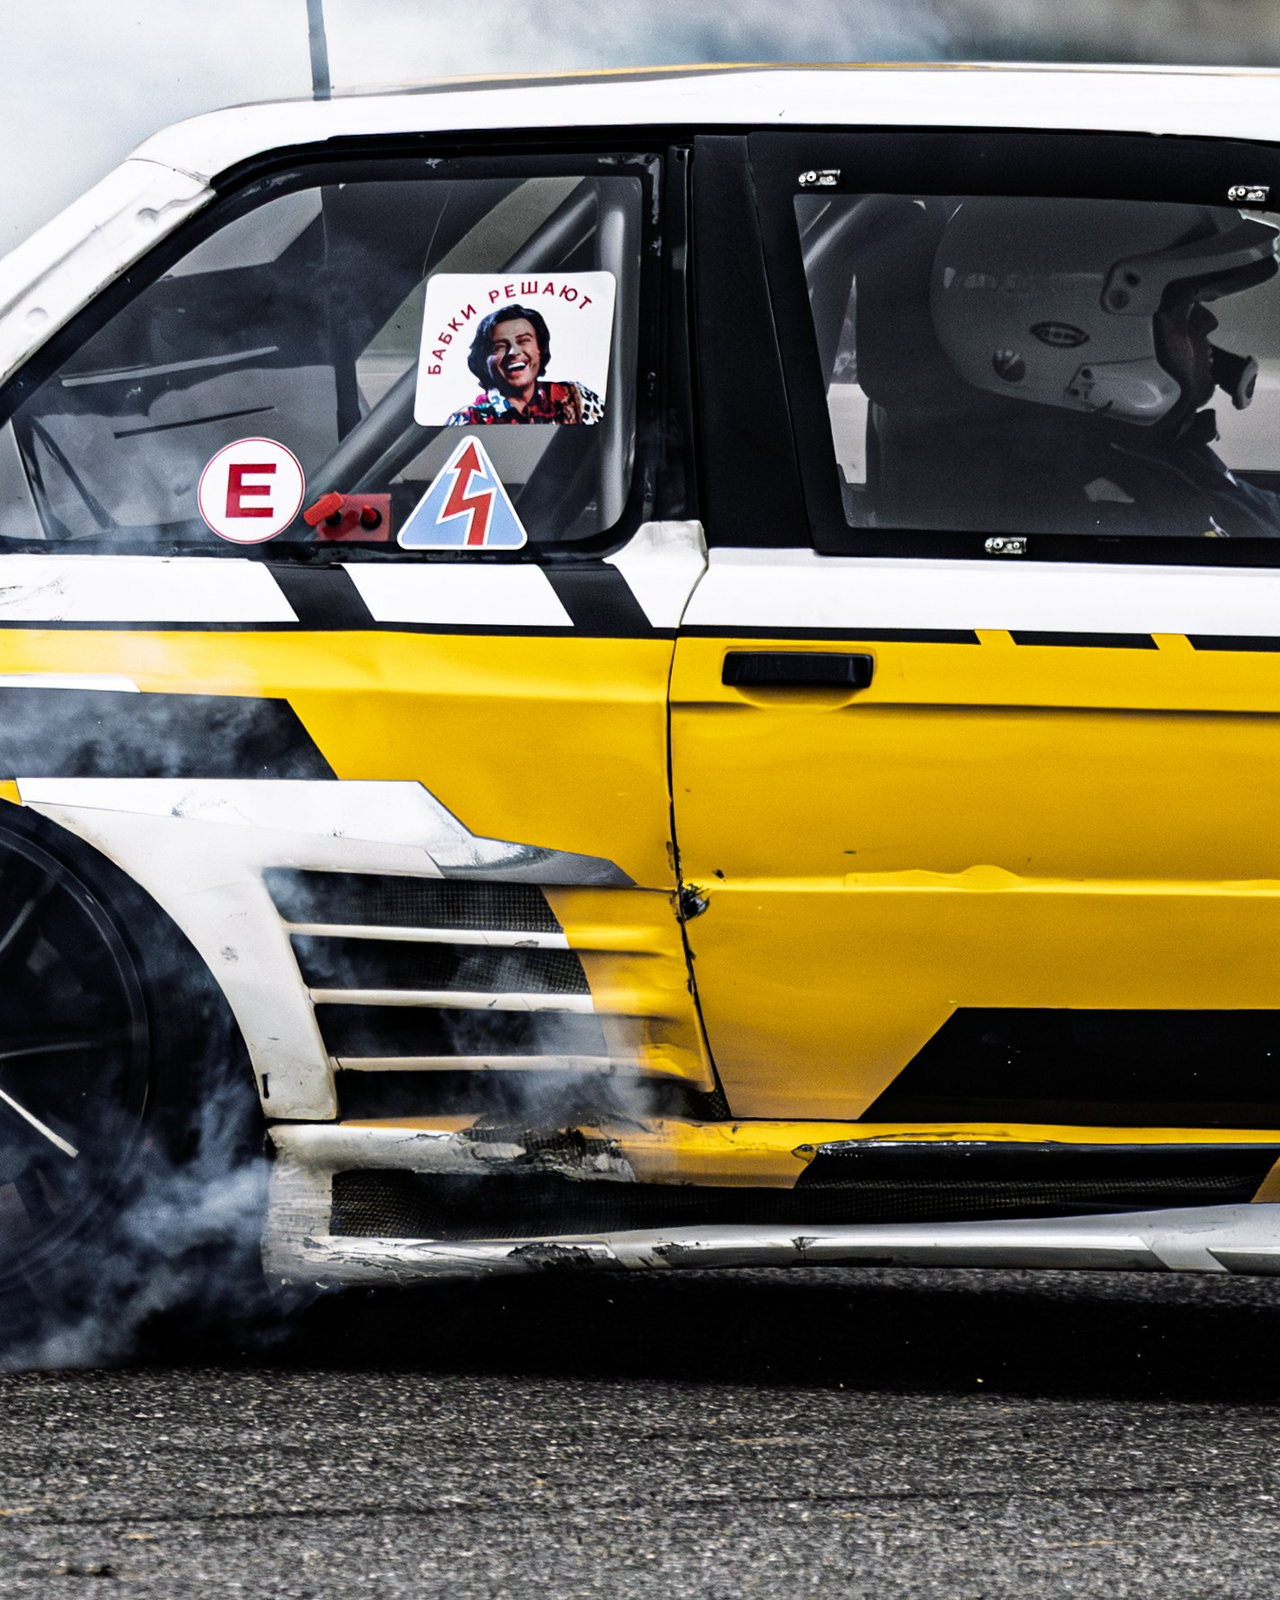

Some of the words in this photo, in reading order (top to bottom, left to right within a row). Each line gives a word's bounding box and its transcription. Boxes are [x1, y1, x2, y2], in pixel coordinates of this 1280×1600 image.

[427, 304, 477, 375] БАБКИ
[488, 281, 592, 310] РЕШАЮТ
[225, 463, 277, 518] E
